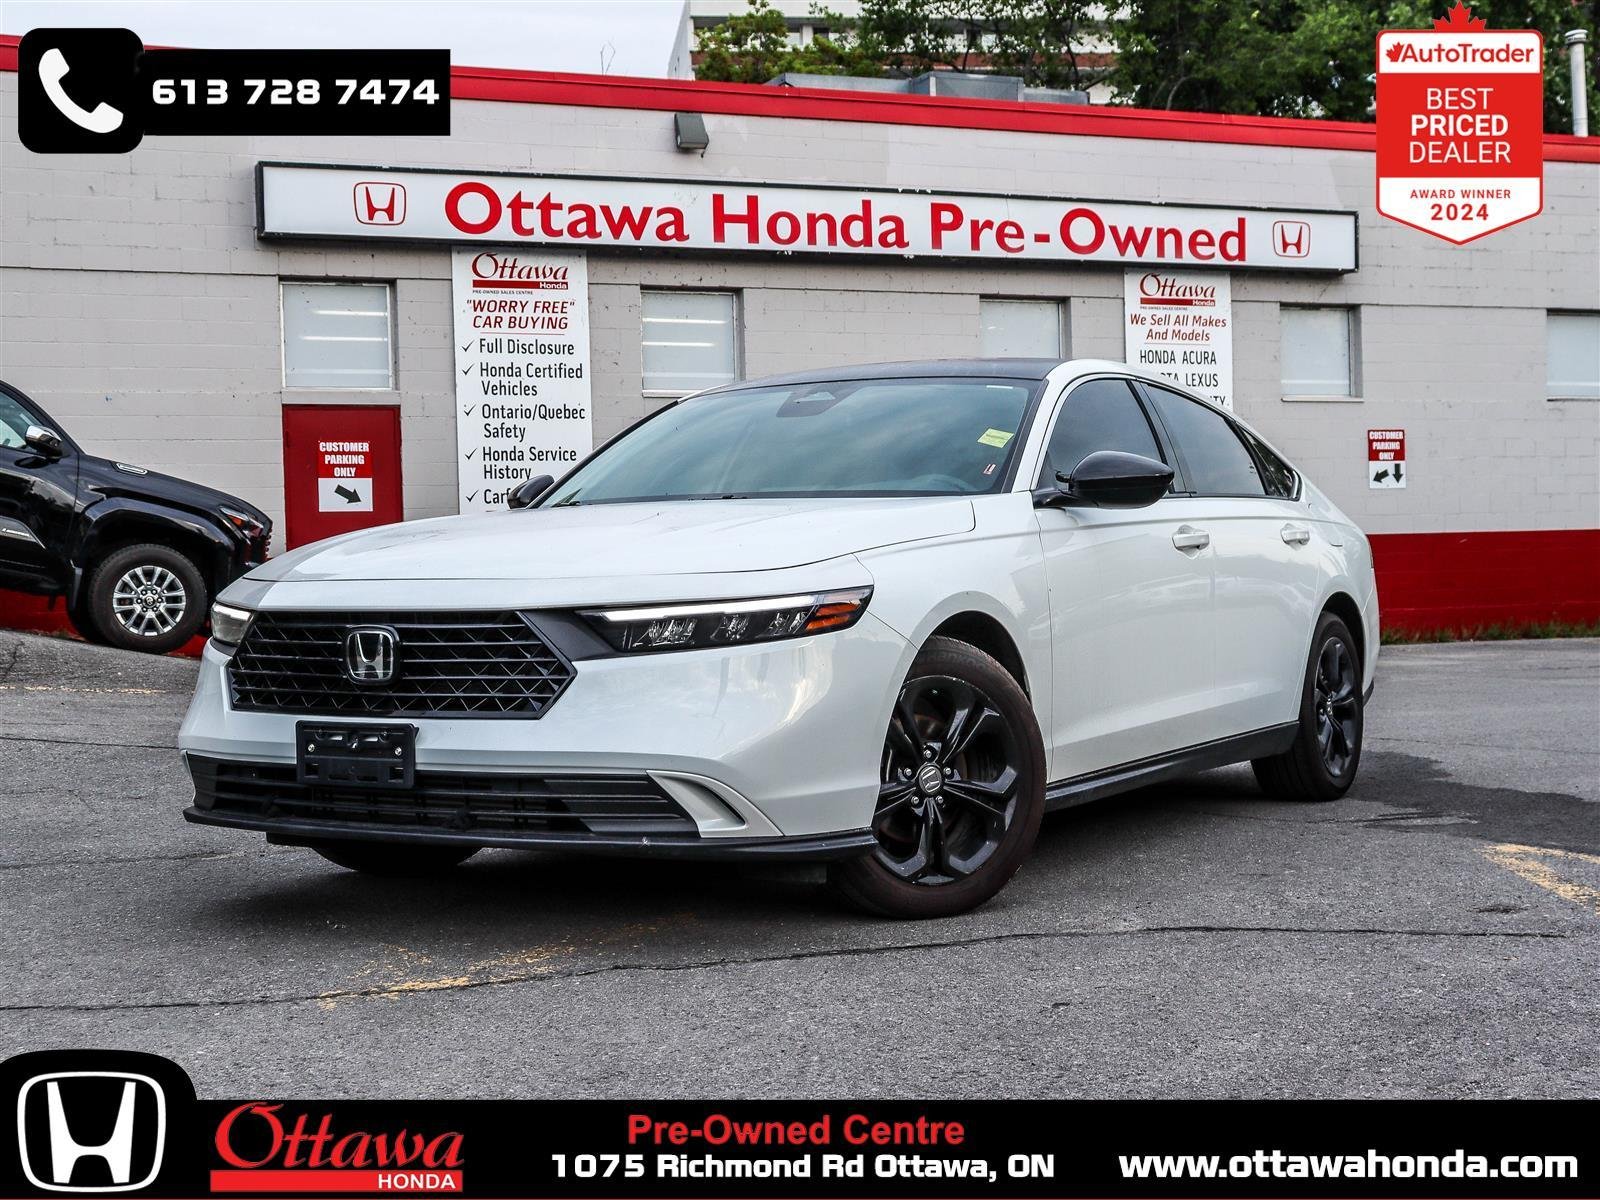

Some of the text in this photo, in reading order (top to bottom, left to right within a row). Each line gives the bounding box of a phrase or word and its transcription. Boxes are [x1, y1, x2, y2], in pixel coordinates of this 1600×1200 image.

[444, 181, 1247, 263] Ottawa Honda Pre-Owned
[471, 252, 569, 280] Ottawa
[539, 281, 568, 290] Honda
[1140, 272, 1216, 299] Ottawa
[472, 315, 569, 330] CAR BUYING
[1130, 313, 1227, 328] We Sell All Makes
[1146, 329, 1211, 342] And Models
[479, 338, 575, 355] Full Disclosure
[1140, 350, 1217, 365] HONDA ACURA
[480, 361, 584, 379] Honda Certified
[1185, 373, 1219, 387] LEXUS
[481, 380, 538, 396] Vehicles
[482, 403, 586, 421] Ontario/Quebec
[483, 422, 526, 442] Safety
[1369, 431, 1403, 440] CUSTOMER
[319, 442, 369, 452] CUSTOMER
[1372, 441, 1401, 450] PARKING
[324, 454, 365, 465] PARKING
[482, 446, 577, 462] Honda Service
[1379, 451, 1395, 460] ONLY
[333, 467, 356, 477] ONLY
[484, 464, 532, 480] History
